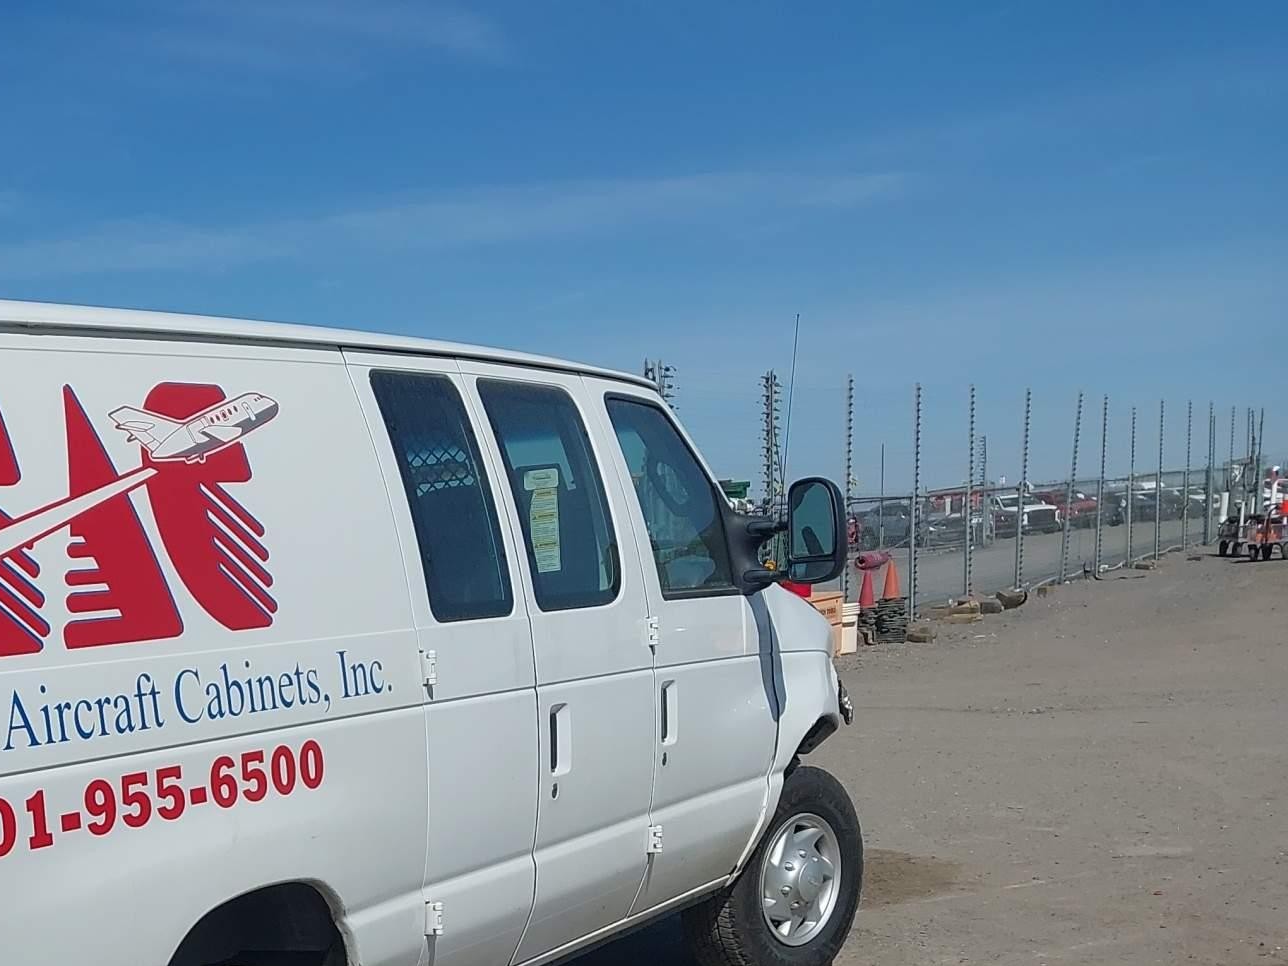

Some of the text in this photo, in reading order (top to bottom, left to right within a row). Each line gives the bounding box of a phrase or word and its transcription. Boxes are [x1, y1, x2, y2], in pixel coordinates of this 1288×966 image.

[4, 672, 163, 750] Aircraft
[173, 660, 331, 726] Cabinets,
[336, 649, 394, 700] Inc.
